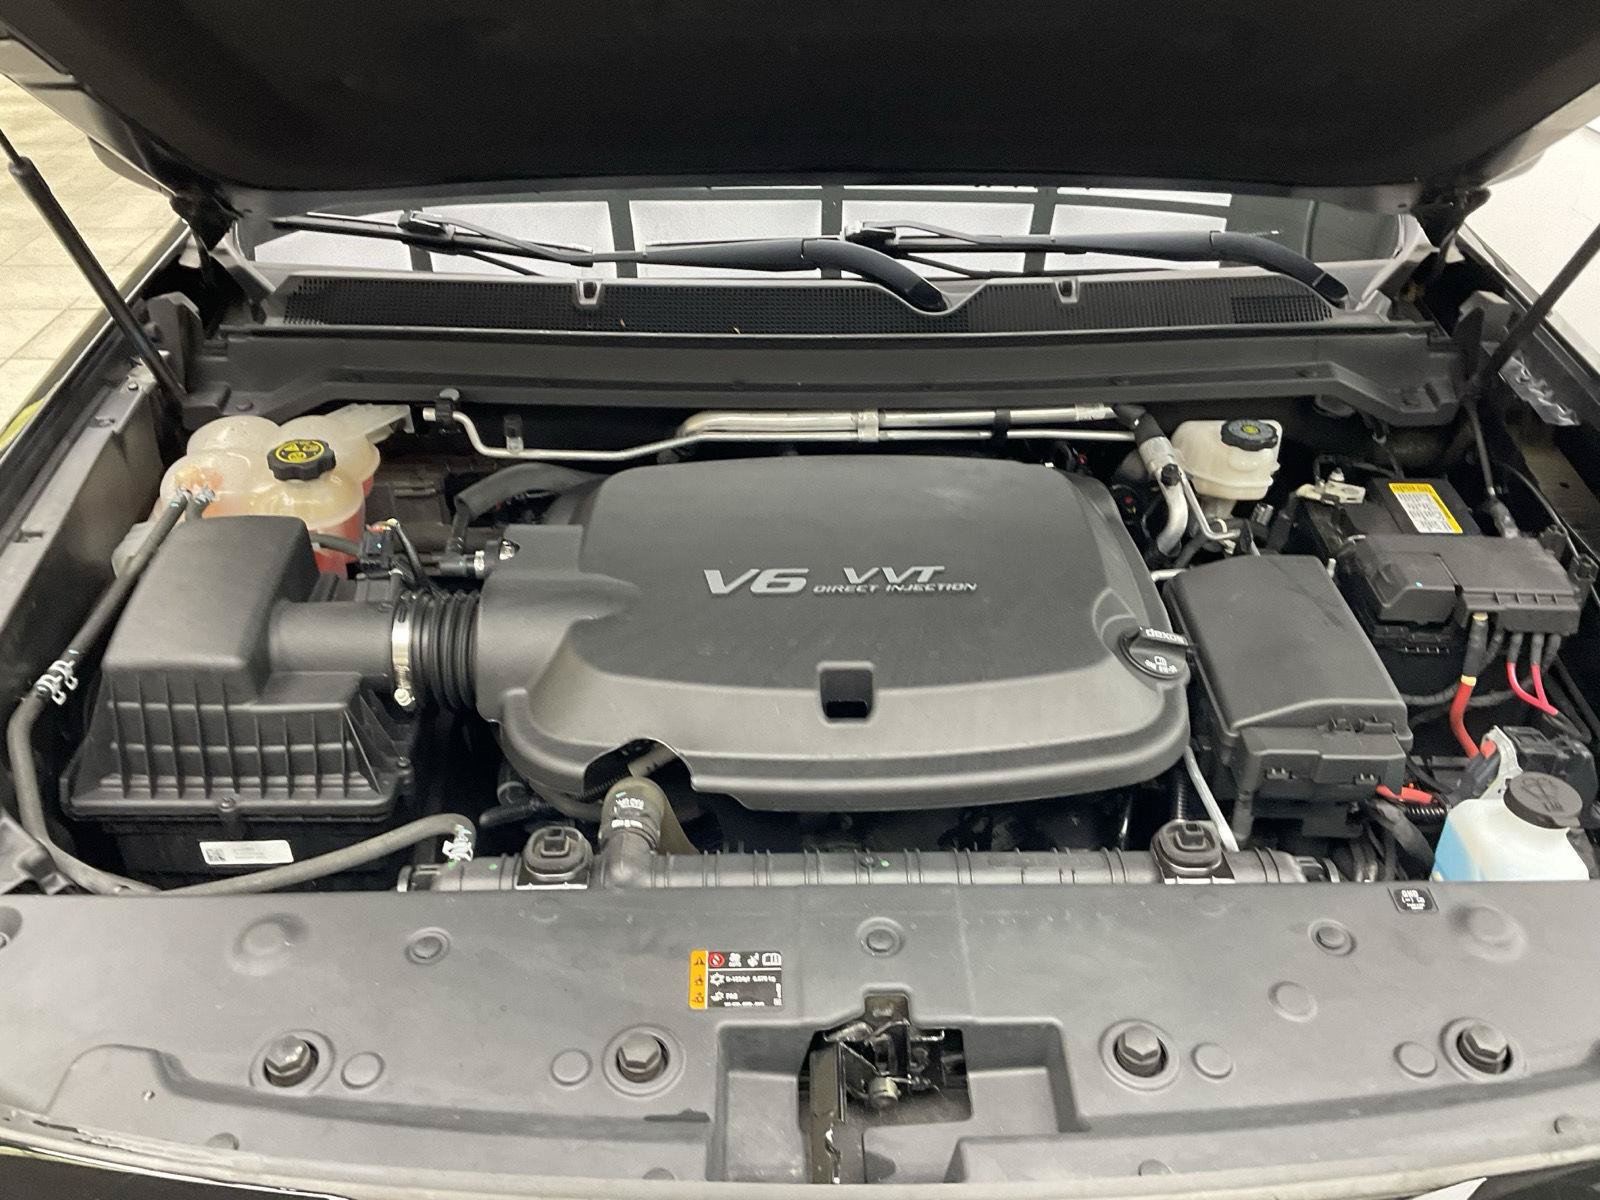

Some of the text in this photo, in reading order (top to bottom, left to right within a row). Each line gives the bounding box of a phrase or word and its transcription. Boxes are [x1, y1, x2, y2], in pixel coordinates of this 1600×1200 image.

[703, 568, 809, 594] V6
[843, 565, 945, 584] VVT
[813, 582, 978, 593] DIRECT INJECTION
